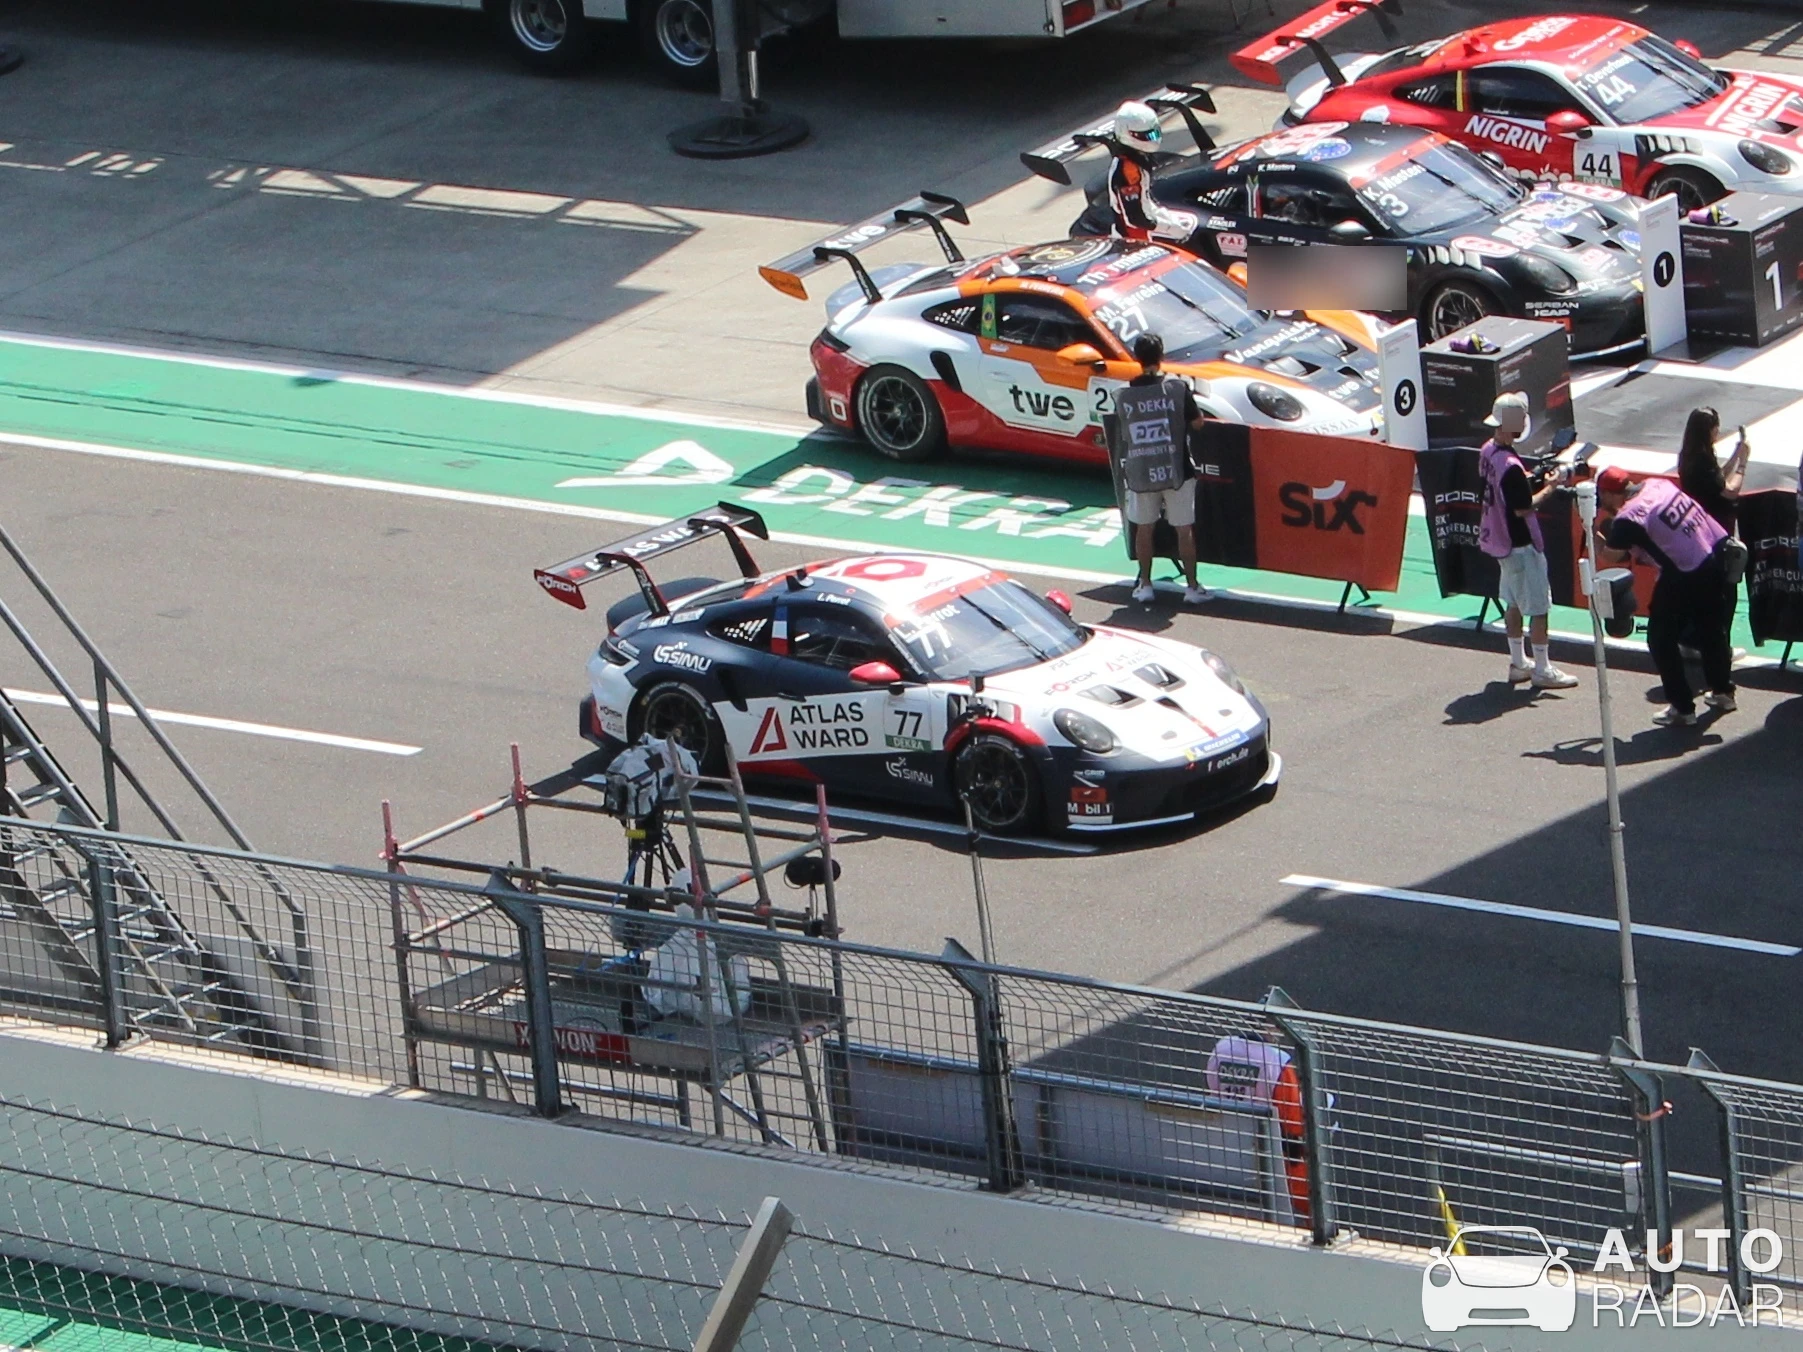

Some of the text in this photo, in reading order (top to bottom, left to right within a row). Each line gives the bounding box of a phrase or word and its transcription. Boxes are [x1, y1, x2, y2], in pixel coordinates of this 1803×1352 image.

[1597, 74, 1637, 106] 44
[1718, 82, 1788, 137] NIGRIN
[1463, 114, 1548, 155] NIGRIN
[1581, 152, 1613, 178] 44
[1362, 186, 1384, 202] K.
[1379, 192, 1409, 218] 3
[824, 224, 888, 250] twe
[1659, 258, 1668, 281] 1
[1765, 260, 1783, 312] 1
[1106, 305, 1149, 343] 27
[1009, 384, 1076, 422] twe
[1094, 386, 1109, 413] 2
[1399, 386, 1411, 409] 3
[1149, 465, 1174, 483] 587
[1435, 490, 1481, 505] POR
[653, 514, 730, 546] WAD
[904, 619, 953, 661] 77
[790, 701, 864, 726] ATLAS
[893, 709, 924, 738] 77
[793, 727, 869, 749] WARD
[893, 736, 925, 751] DEKRA
[1067, 802, 1101, 814] Mbil
[517, 1023, 597, 1054] XVON
